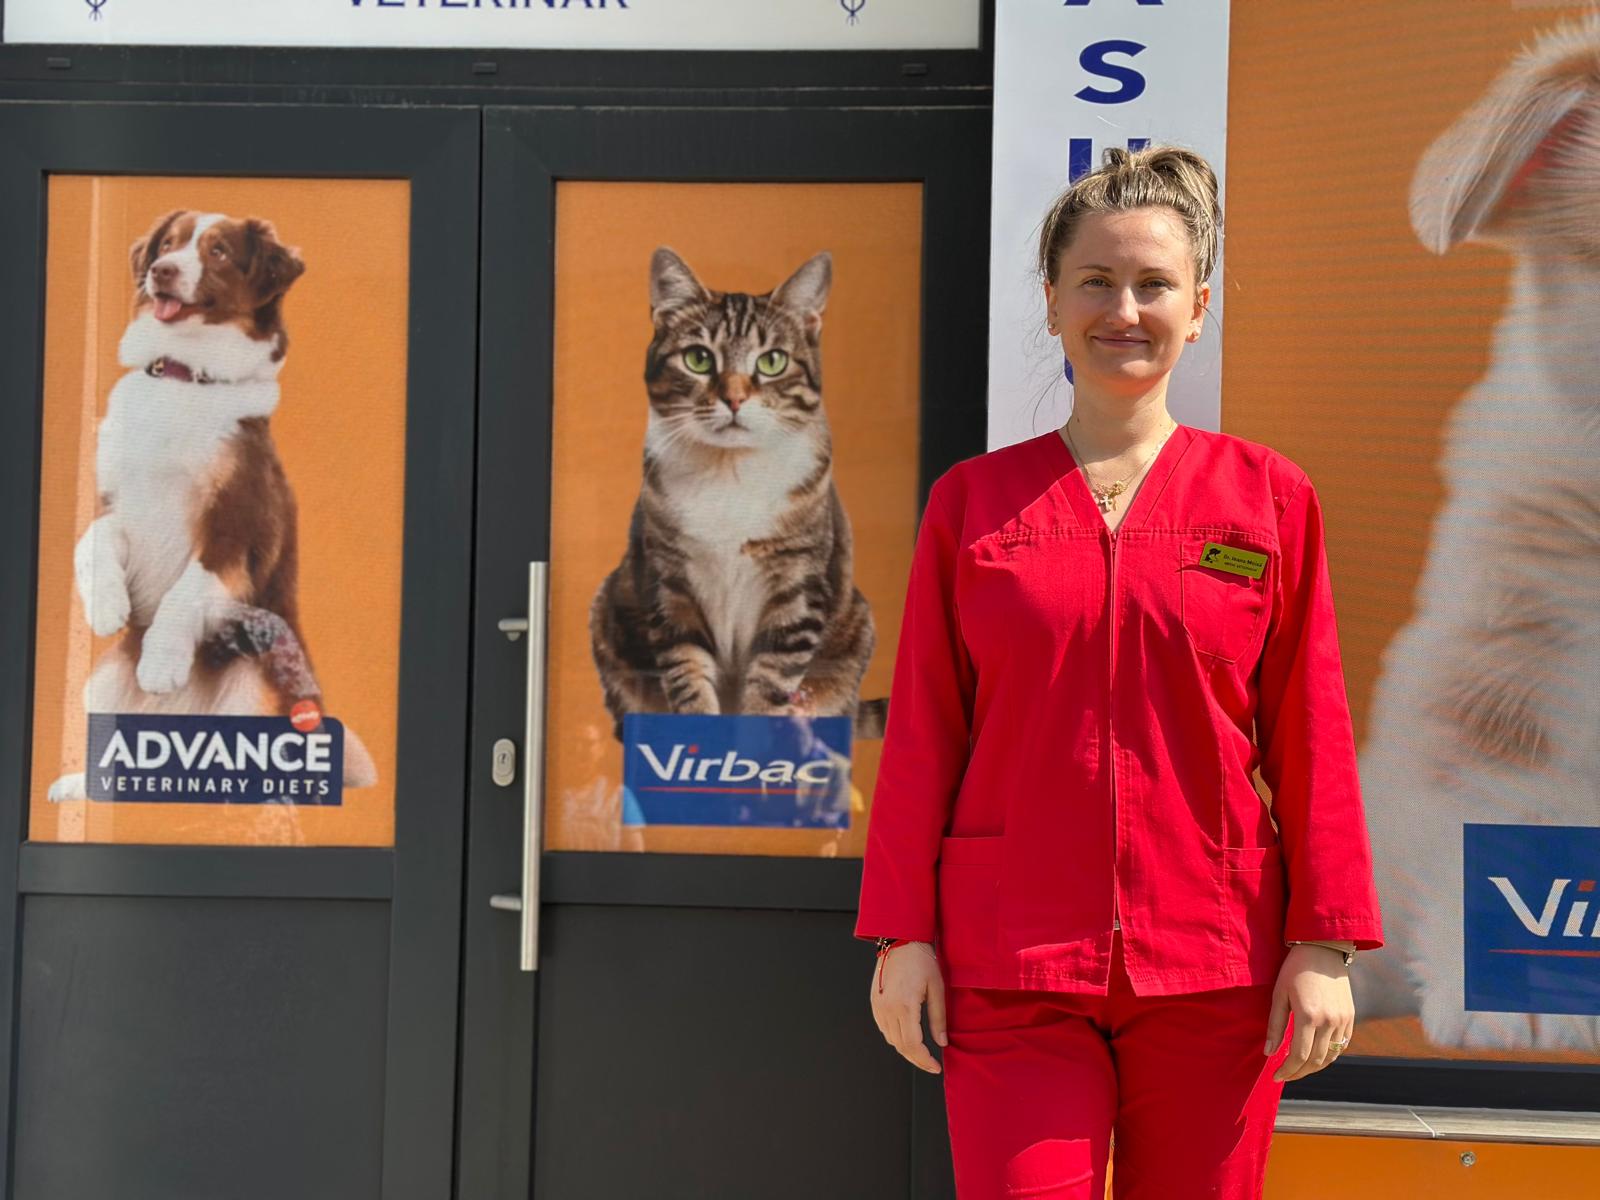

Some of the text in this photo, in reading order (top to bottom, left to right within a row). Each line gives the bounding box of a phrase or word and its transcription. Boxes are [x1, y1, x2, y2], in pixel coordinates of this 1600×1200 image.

[99, 730, 332, 772] ADVANCE
[637, 743, 834, 784] Virbac
[101, 776, 329, 796] VETERINARY DIETS
[1487, 876, 1600, 938] Vi
